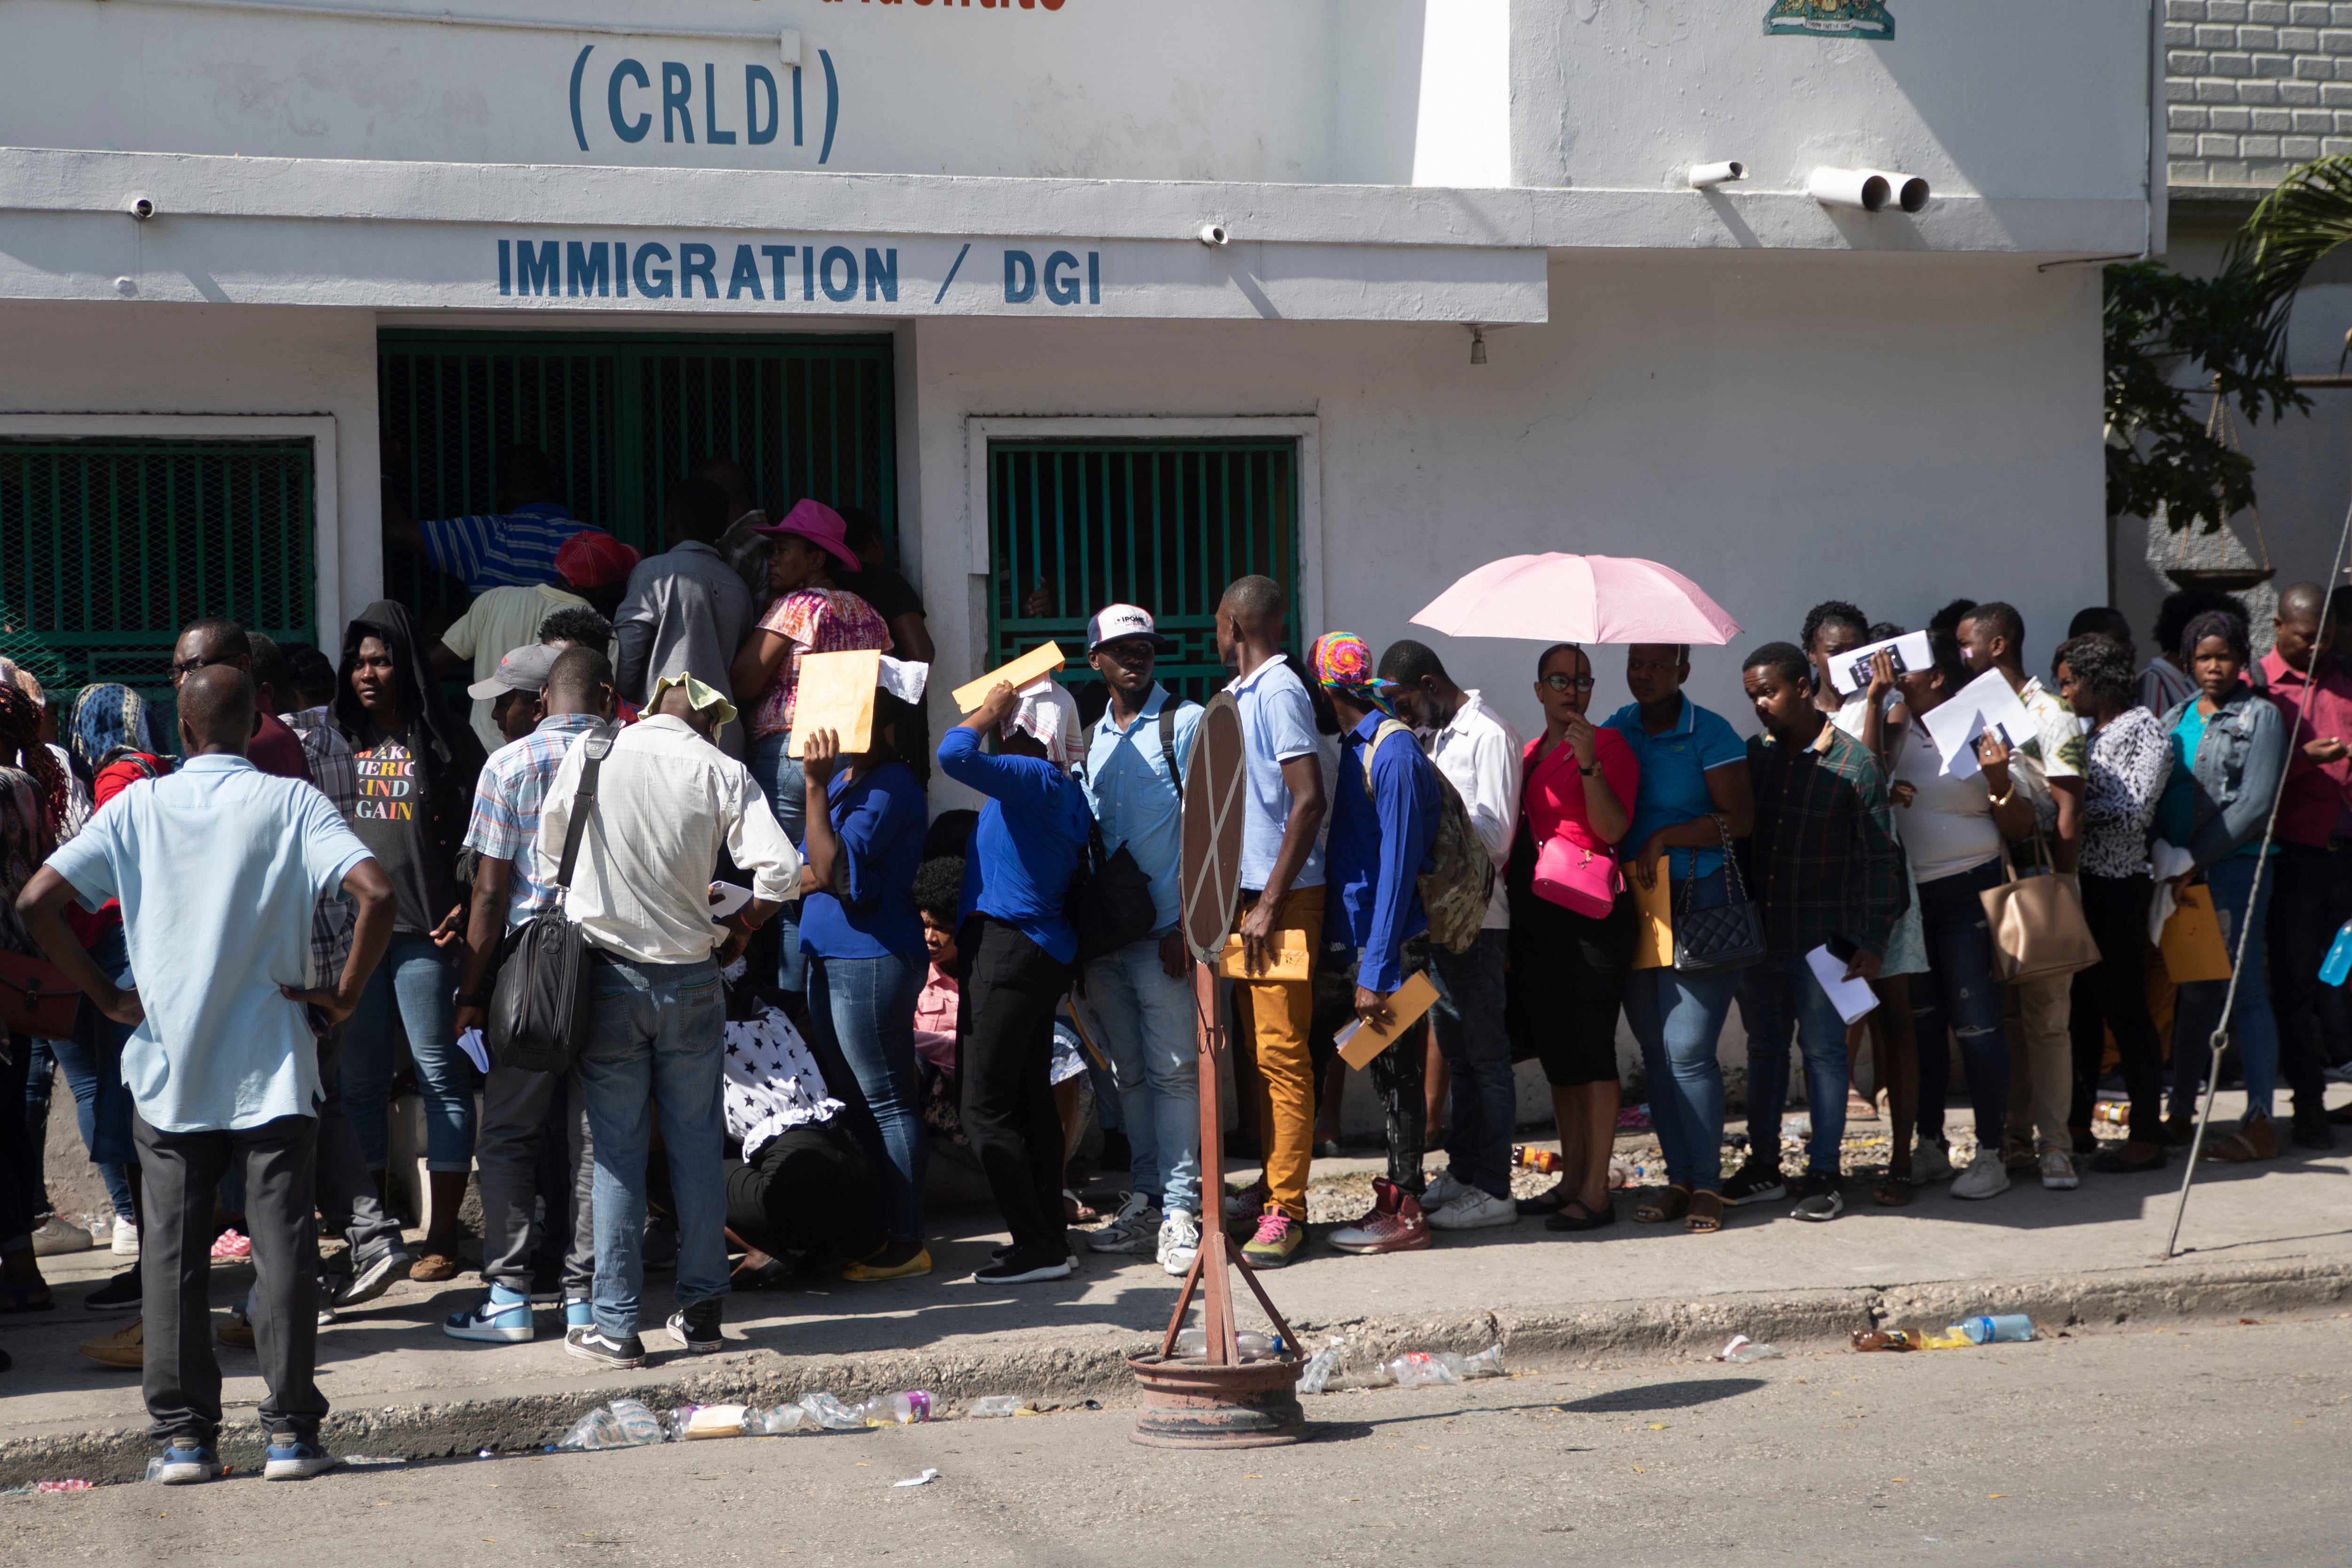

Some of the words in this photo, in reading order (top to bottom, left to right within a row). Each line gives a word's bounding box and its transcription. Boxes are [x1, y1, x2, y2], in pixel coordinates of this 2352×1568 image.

[569, 45, 839, 165] (CRLDI)
[498, 239, 898, 302] IMMIGRATION
[934, 243, 971, 305] /
[1004, 250, 1100, 306] DGI
[357, 760, 415, 776] MERIC
[354, 800, 414, 821] GAIN
